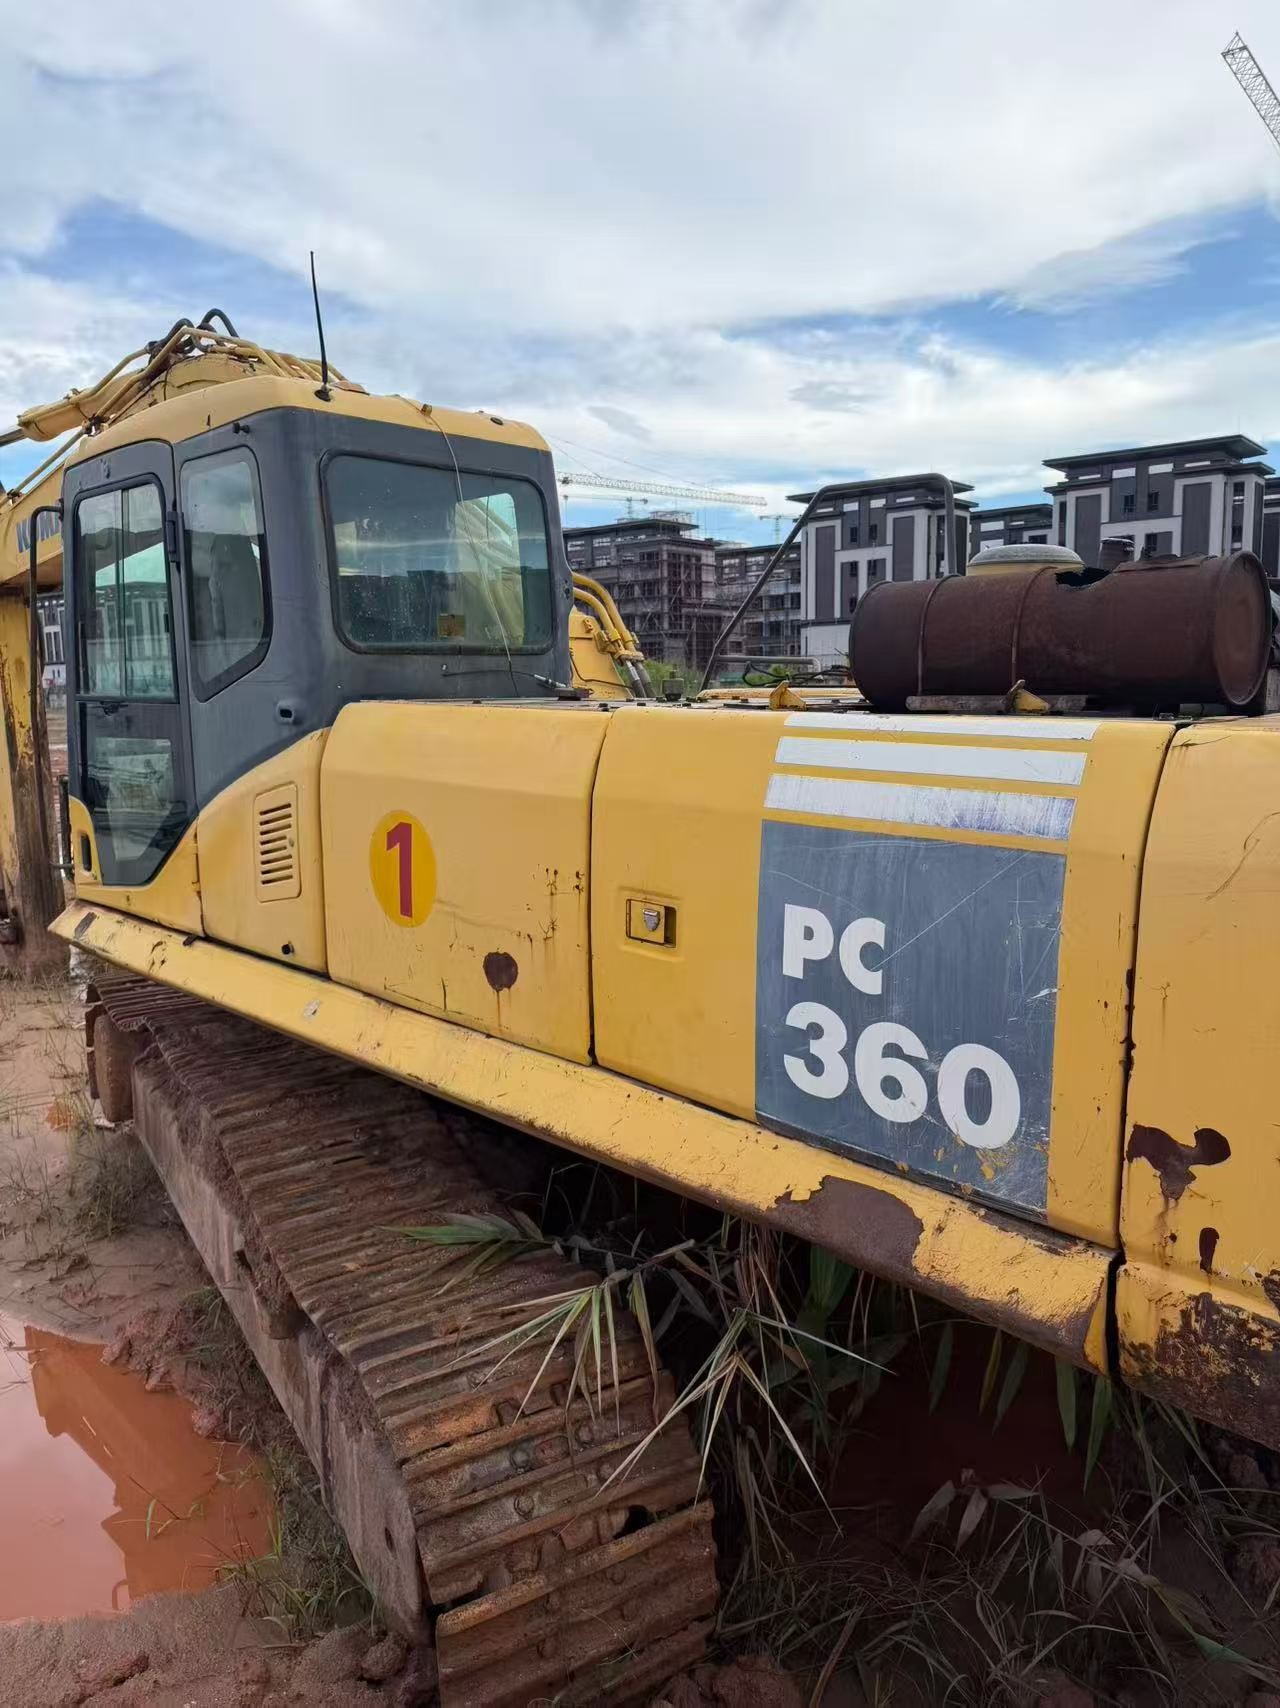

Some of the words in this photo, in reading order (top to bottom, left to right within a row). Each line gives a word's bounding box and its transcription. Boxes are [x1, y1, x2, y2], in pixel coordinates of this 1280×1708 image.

[386, 823, 413, 918] 1
[782, 903, 886, 995] PC
[783, 1001, 1021, 1149] 360
